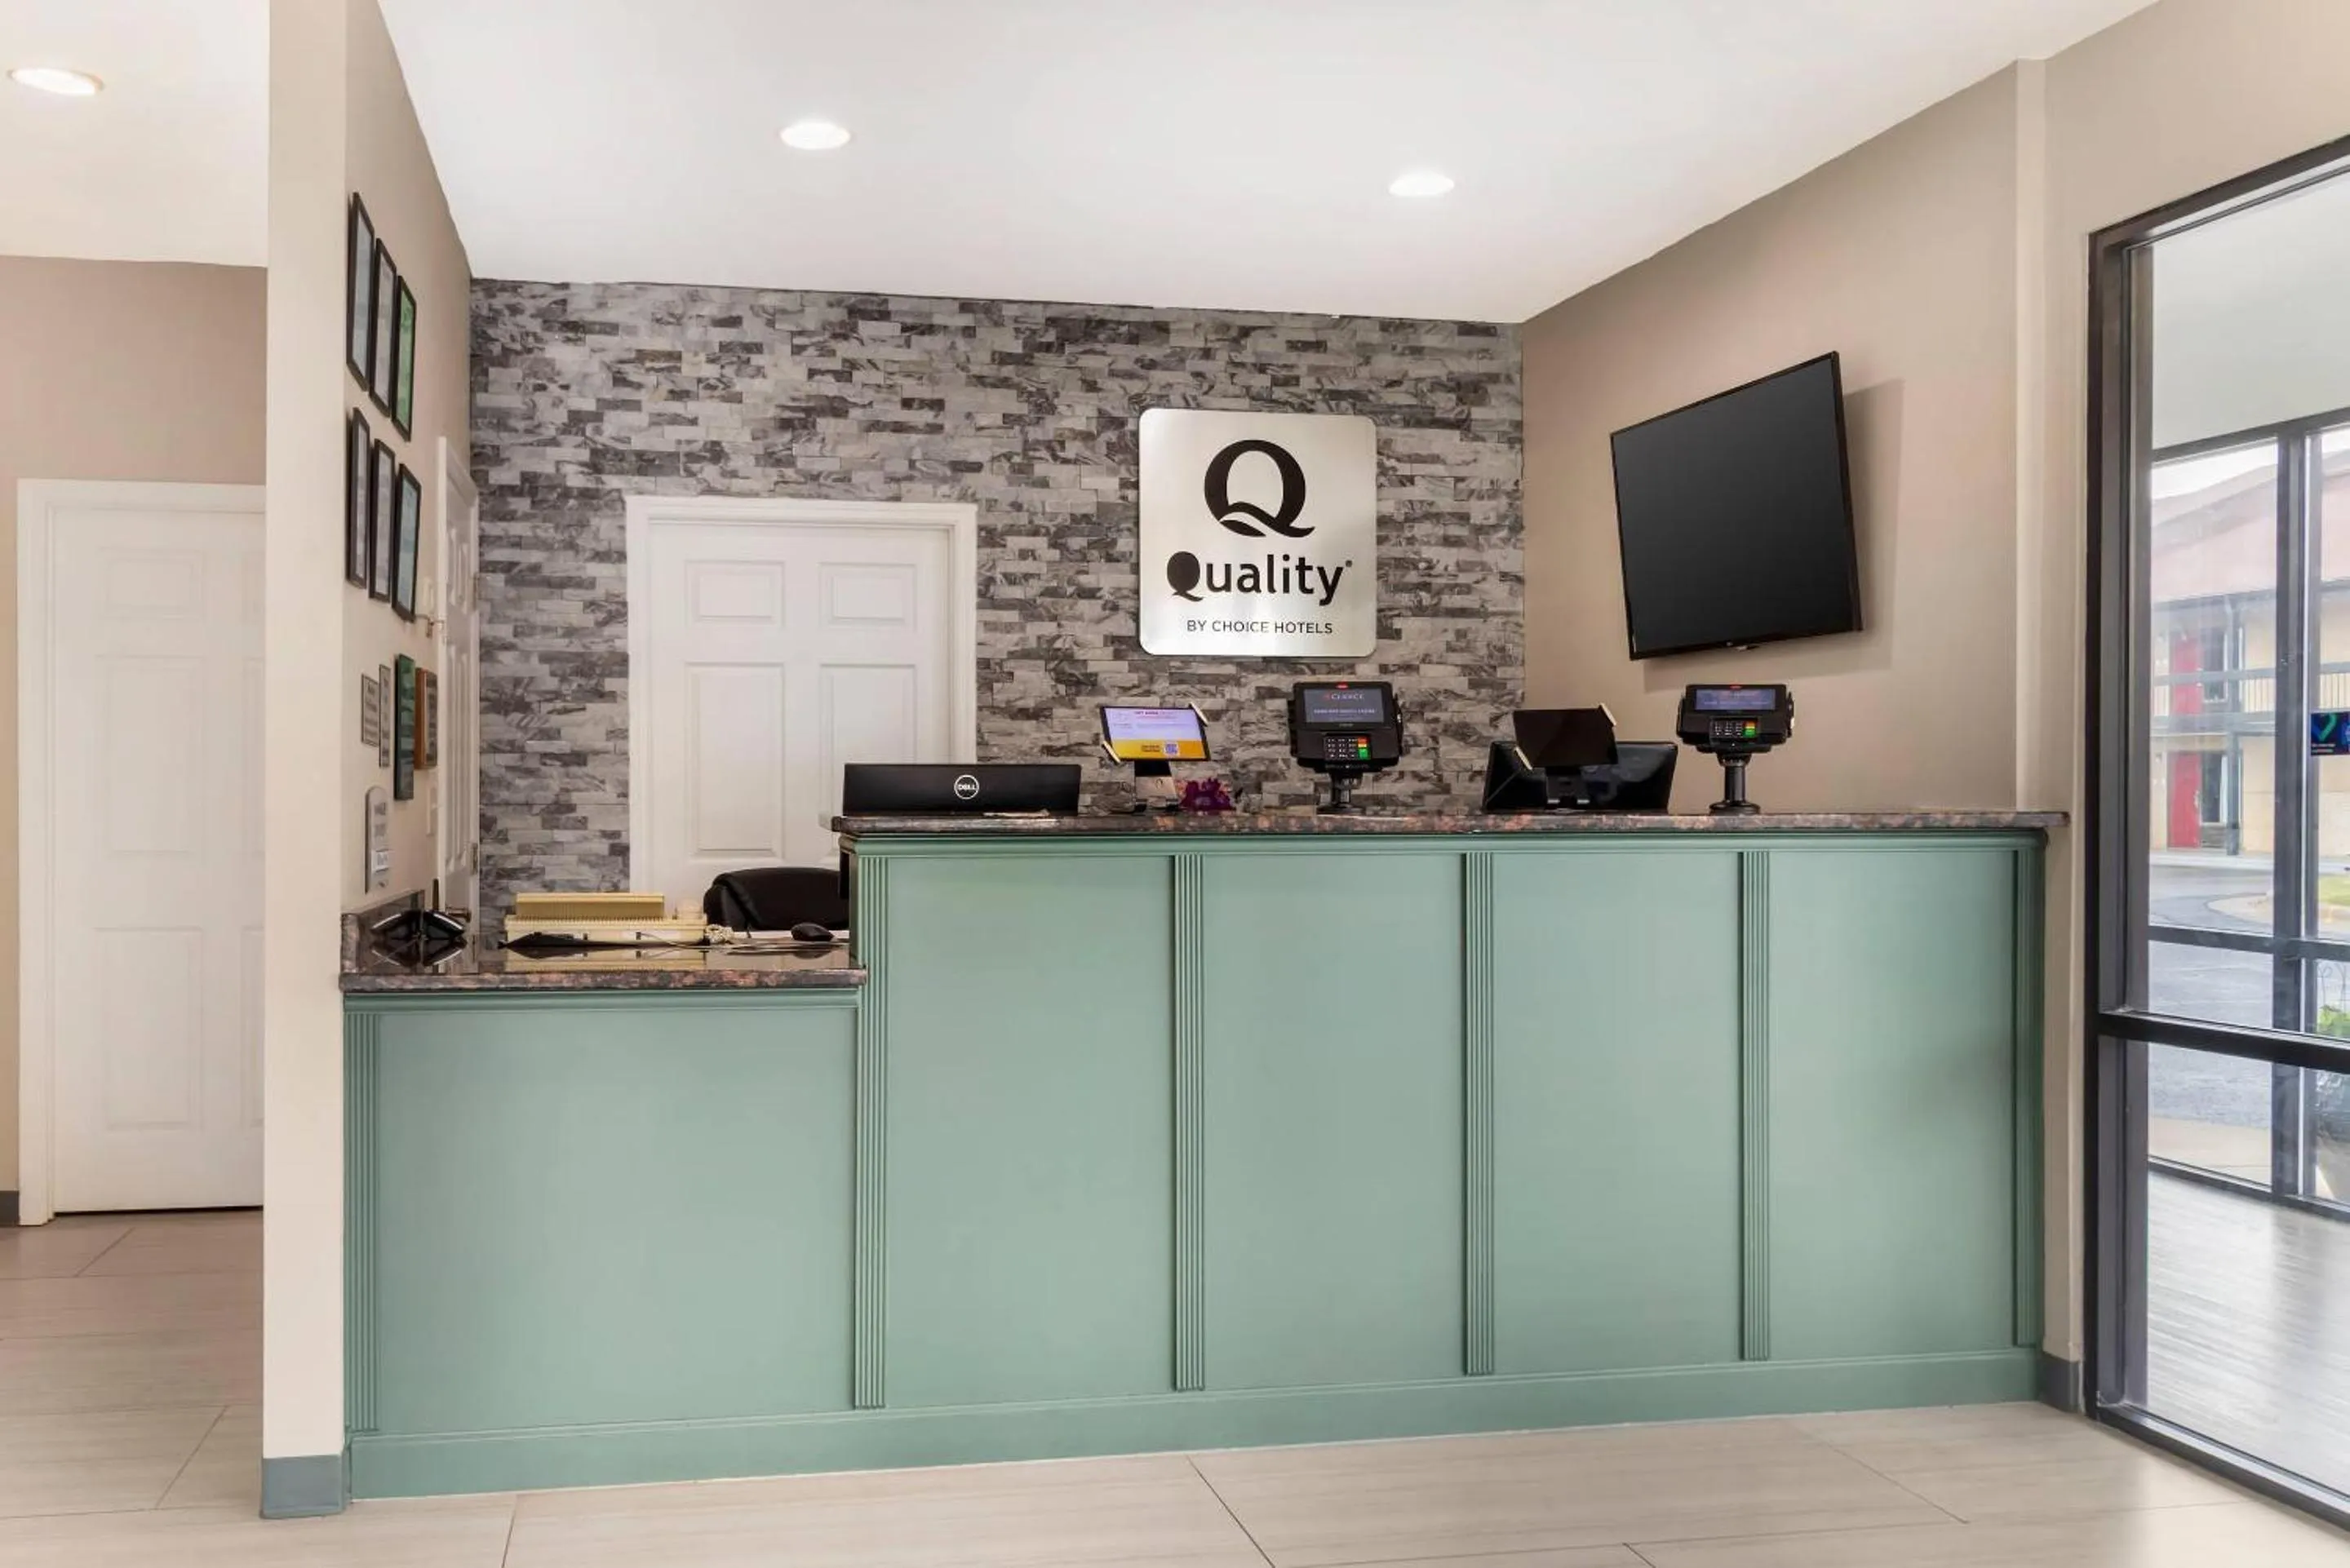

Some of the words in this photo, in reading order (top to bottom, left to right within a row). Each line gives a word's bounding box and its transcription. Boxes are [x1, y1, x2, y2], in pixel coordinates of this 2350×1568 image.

[1204, 439, 1315, 538] Q
[1166, 551, 1345, 606] Quality
[1186, 619, 1207, 632] BY
[1212, 620, 1270, 633] CHOICE
[1274, 622, 1333, 634] HOTELS
